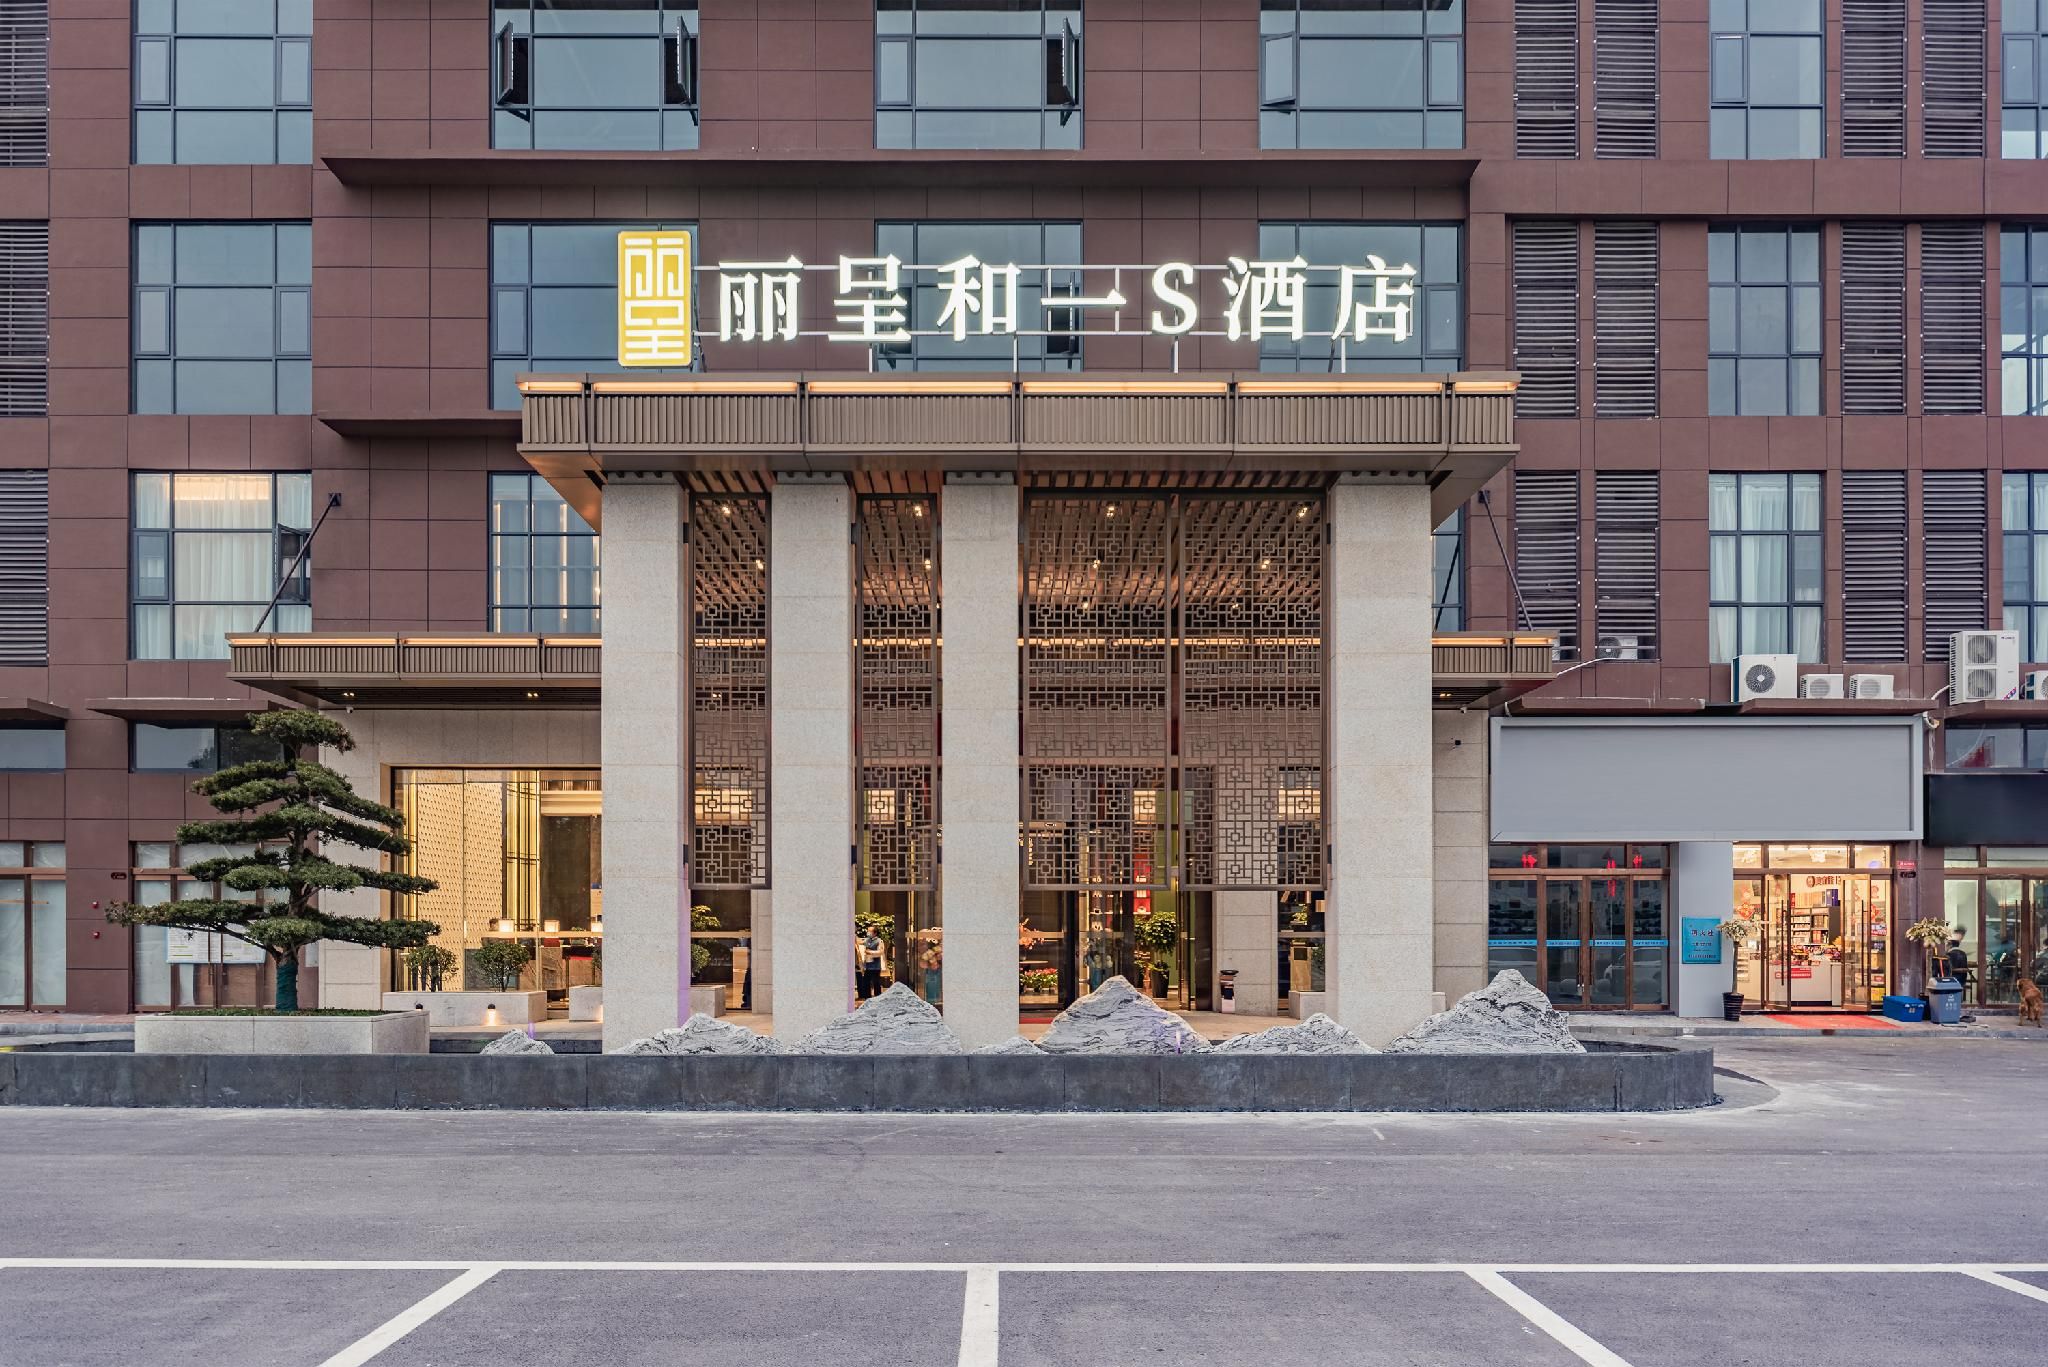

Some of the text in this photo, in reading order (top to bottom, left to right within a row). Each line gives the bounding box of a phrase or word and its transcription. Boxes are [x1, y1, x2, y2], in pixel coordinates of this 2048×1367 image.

[718, 254, 1418, 342] 丽呈和一S酒店
